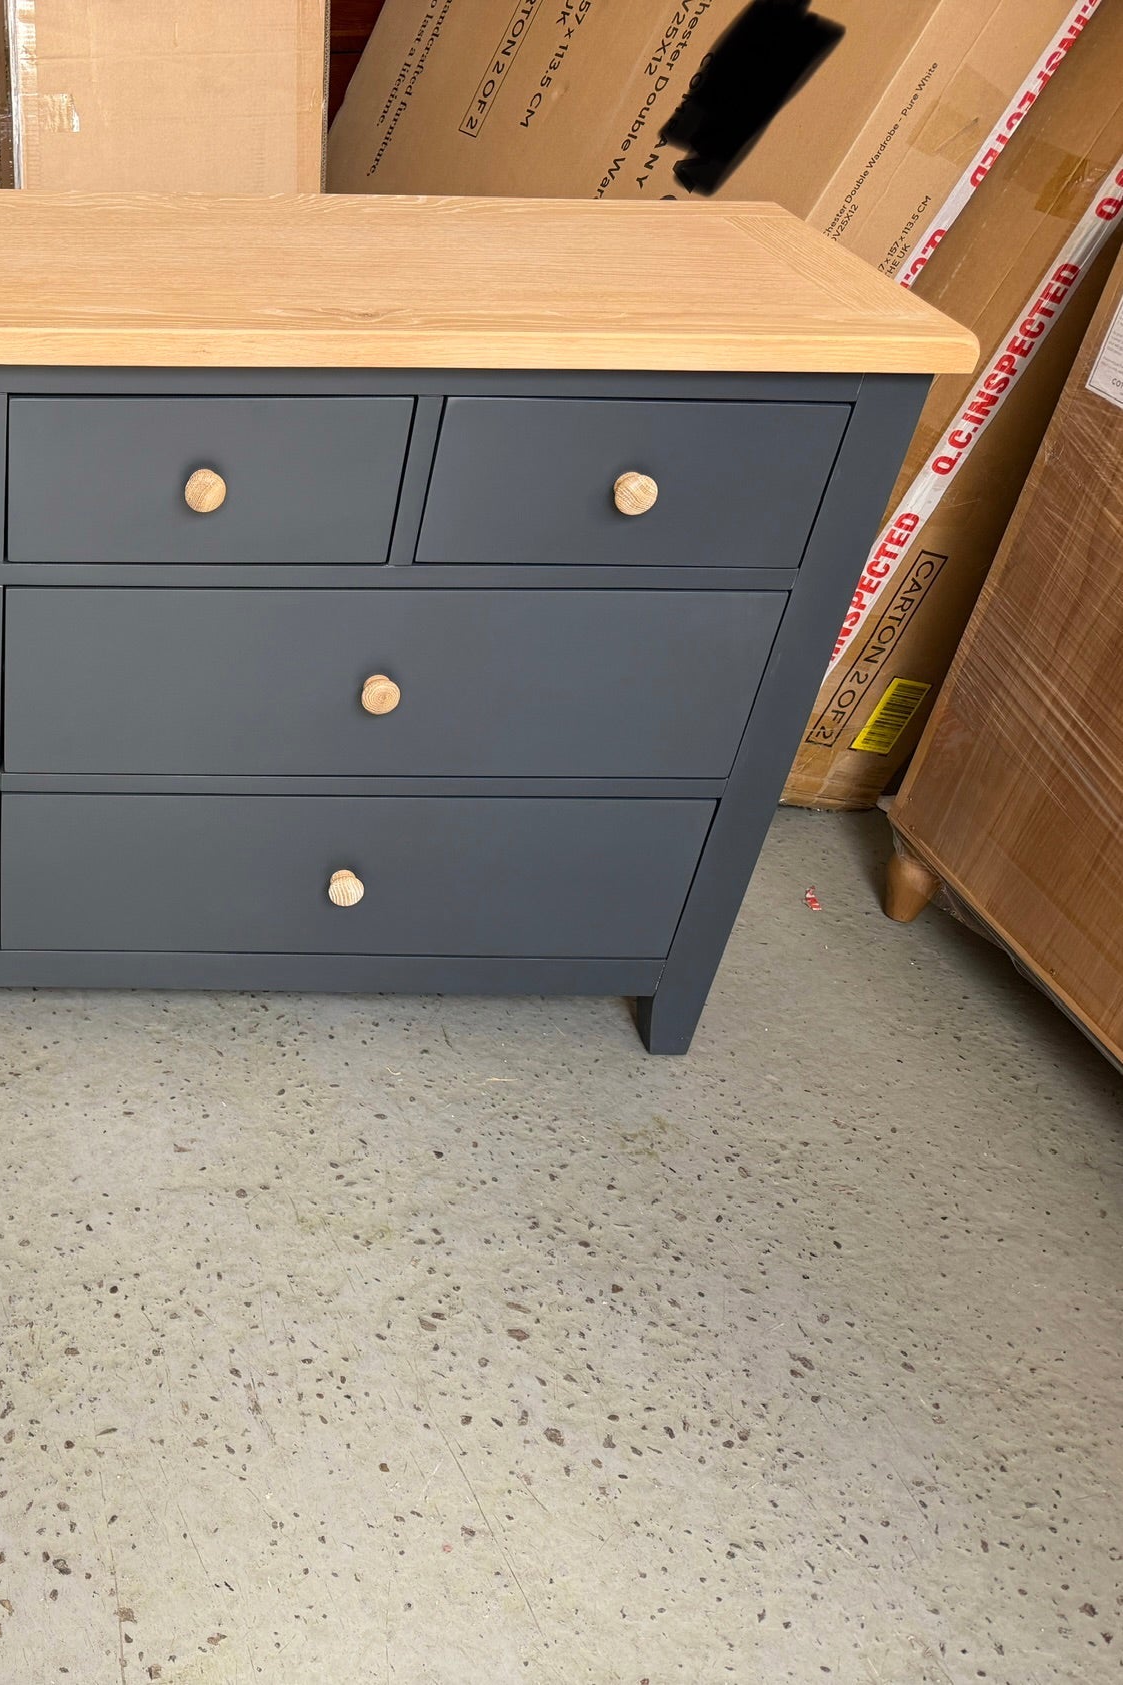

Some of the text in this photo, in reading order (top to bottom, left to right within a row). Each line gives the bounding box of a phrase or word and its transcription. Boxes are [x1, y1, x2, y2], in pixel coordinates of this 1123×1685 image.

[415, 14, 433, 44] last
[564, 27, 575, 39] x
[408, 47, 416, 57] a
[492, 60, 505, 74] 2
[540, 44, 569, 88] 113.5
[376, 62, 411, 127] lifetime.
[477, 80, 495, 114] OF
[520, 92, 542, 128] CM
[466, 116, 478, 130] 2
[621, 75, 669, 151] Double
[845, 170, 869, 205] Double
[866, 123, 899, 169] Wardrobe
[901, 93, 919, 117] Pure
[916, 62, 938, 92] White
[594, 157, 626, 199] War
[887, 241, 900, 257] 157
[900, 213, 919, 234] 113.5
[918, 195, 931, 214] CM
[885, 243, 911, 277] HE UK
[815, 560, 934, 740] CARTON 2 OF 2
